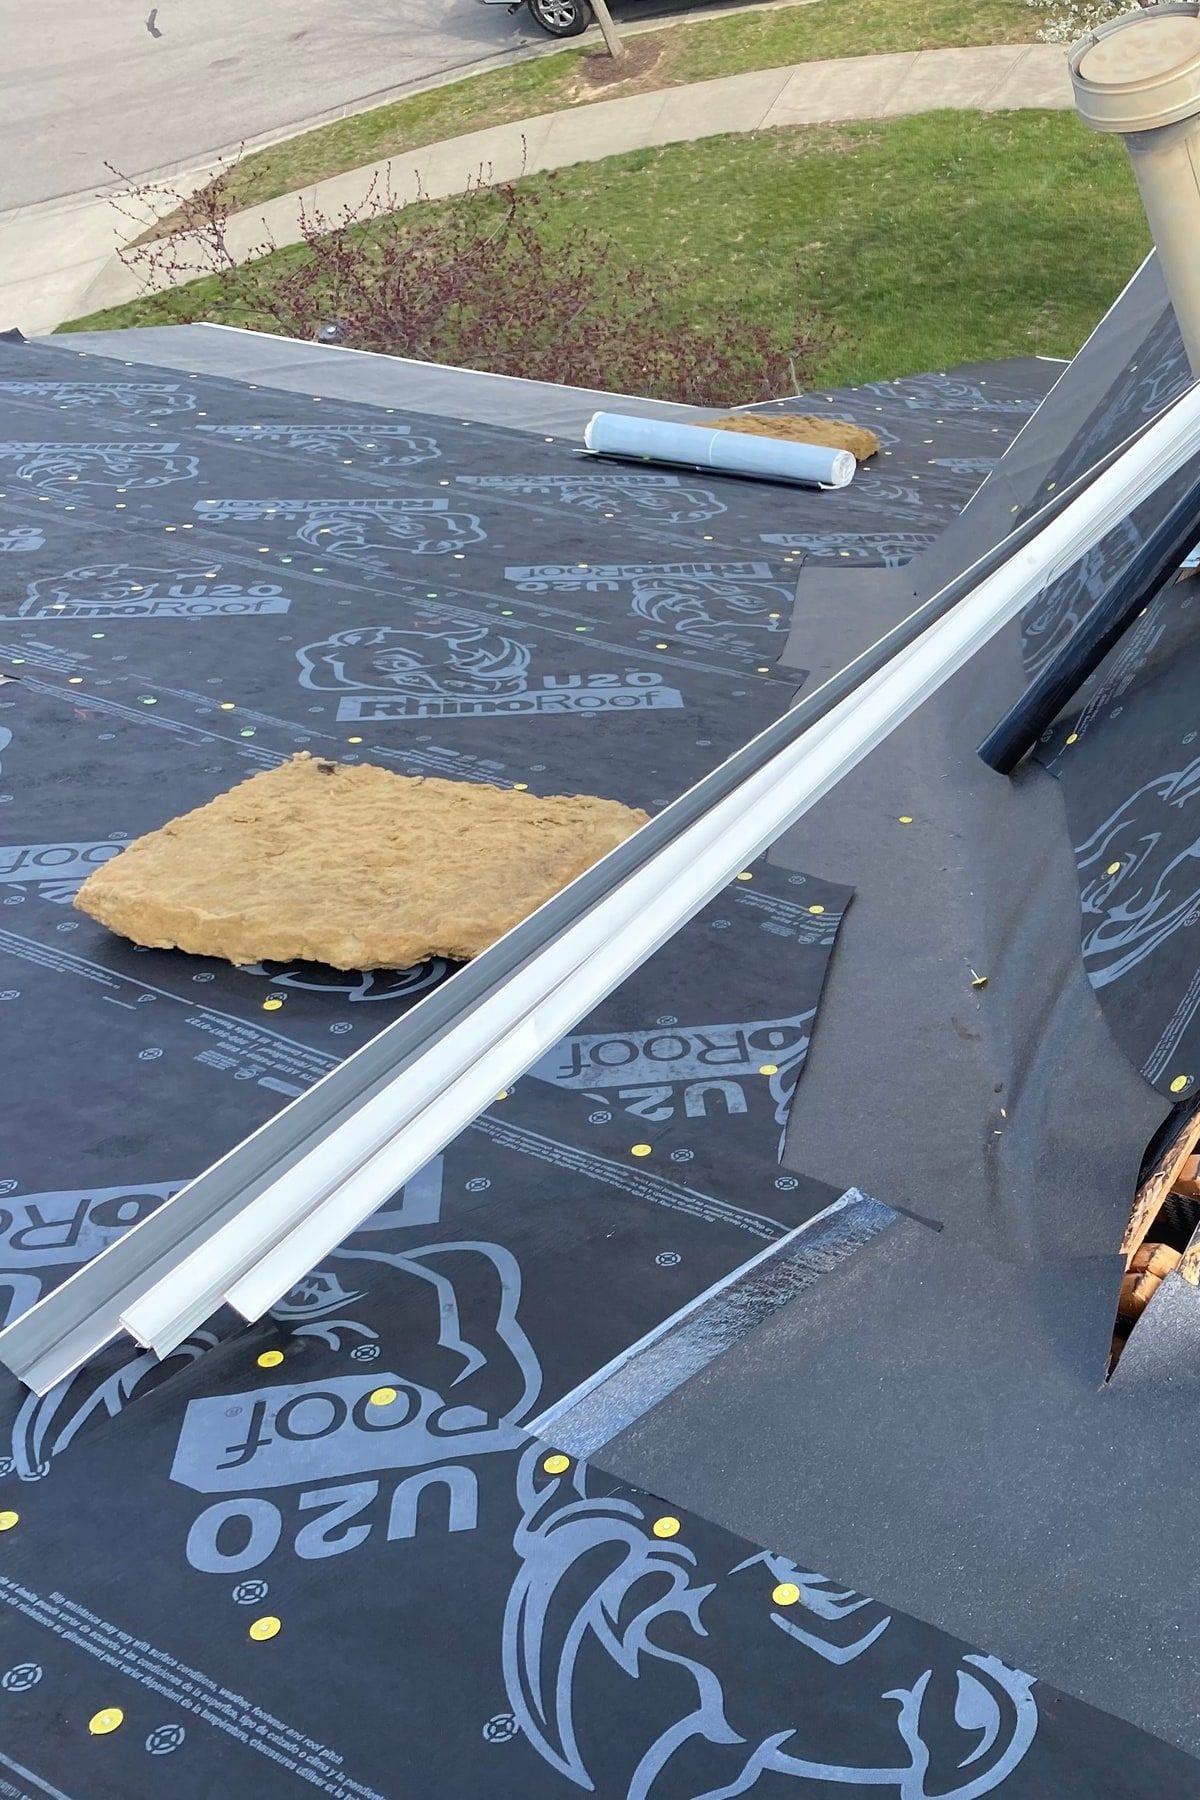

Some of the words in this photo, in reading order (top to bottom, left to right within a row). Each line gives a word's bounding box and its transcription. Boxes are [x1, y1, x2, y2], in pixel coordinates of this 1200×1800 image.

[526, 563, 758, 579] RhinoRoof
[168, 583, 283, 598] U20
[516, 580, 621, 593] U20
[27, 600, 273, 617] hinoRoof
[543, 671, 664, 689] U20
[358, 690, 661, 718] RhinoRoof
[185, 1465, 478, 1574] U20
[33, 1598, 60, 1615] puede
[89, 1631, 120, 1651] acuerdo
[137, 1658, 183, 1686] condiciones
[239, 1714, 257, 1729] tipo
[49, 1592, 65, 1604] Slip
[63, 1600, 101, 1624] resistance
[99, 1622, 119, 1635] may
[116, 1631, 135, 1644] vary
[132, 1640, 150, 1652] with
[148, 1648, 178, 1667] surface
[176, 1664, 217, 1692] conditions,
[218, 1688, 252, 1711] weather,
[251, 1707, 288, 1731] footwear
[286, 1727, 305, 1741] and
[302, 1738, 325, 1755] roof
[318, 1745, 343, 1765] pitch
